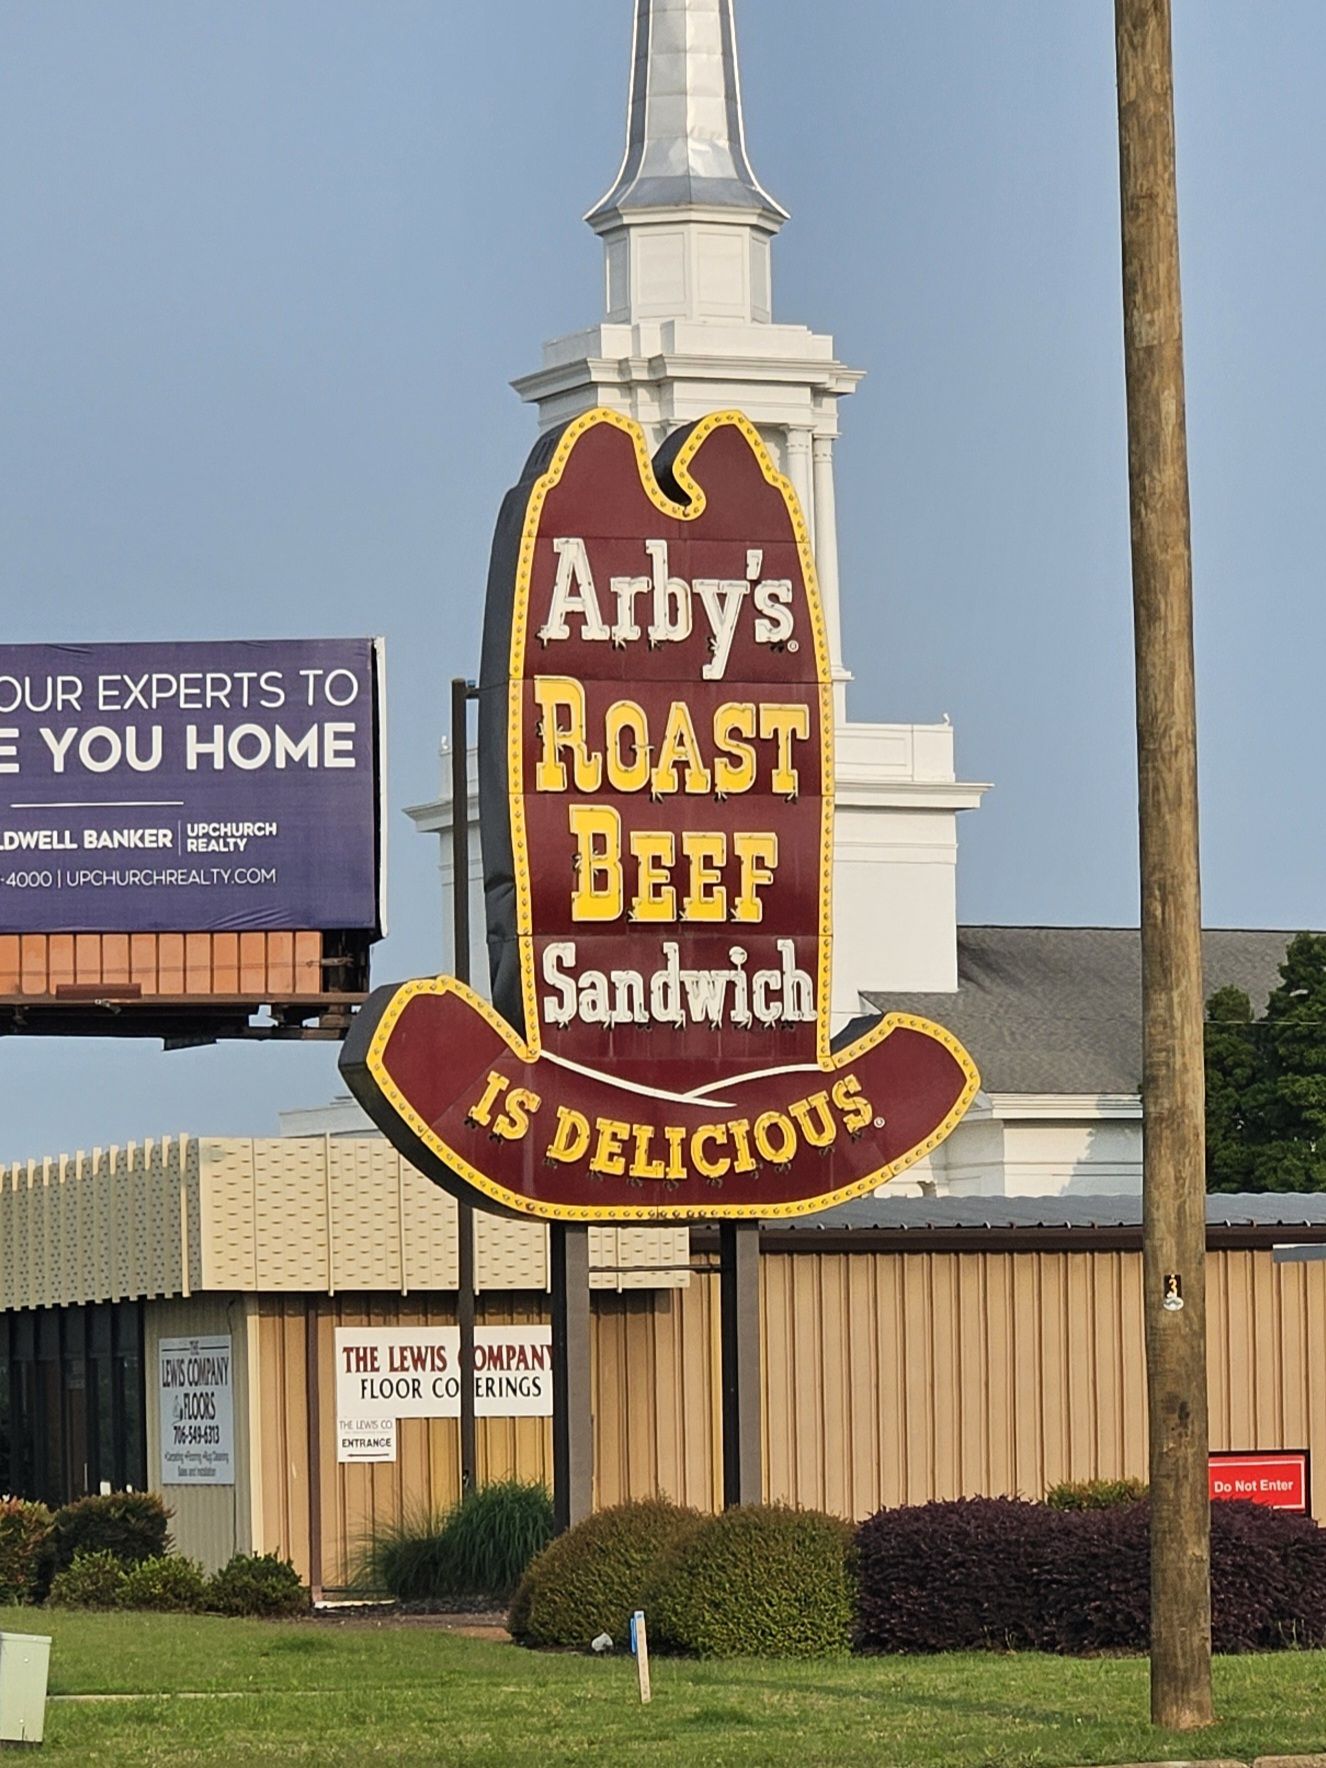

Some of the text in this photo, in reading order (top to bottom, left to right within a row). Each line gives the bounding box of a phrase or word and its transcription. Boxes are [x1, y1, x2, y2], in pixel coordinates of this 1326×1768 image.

[540, 538, 794, 679] Arby's
[98, 671, 285, 710] EXPERTS
[299, 669, 358, 706] TO
[39, 725, 163, 773] YOU
[186, 722, 356, 770] HOME
[534, 675, 810, 793] ROAST
[84, 829, 173, 849] BANKER
[186, 822, 278, 838] UPCHURCH
[186, 838, 248, 852] REALTY
[67, 868, 277, 887] UPCHURCHREALTY.COM
[569, 804, 778, 922] BEEF
[543, 939, 818, 1023] Sandwich
[468, 1071, 873, 1179] IS DELICIOUS
[1167, 1279, 1178, 1298] 3
[162, 1356, 229, 1388] LEWIS COMPANY
[342, 1344, 552, 1373] THE LEWIS OMPAN
[361, 1376, 542, 1400] FLOOR COERINGS
[184, 1391, 216, 1420] FLOORS
[342, 1438, 391, 1448] ENTRANCE
[1214, 1479, 1293, 1493] Do Not Enter
